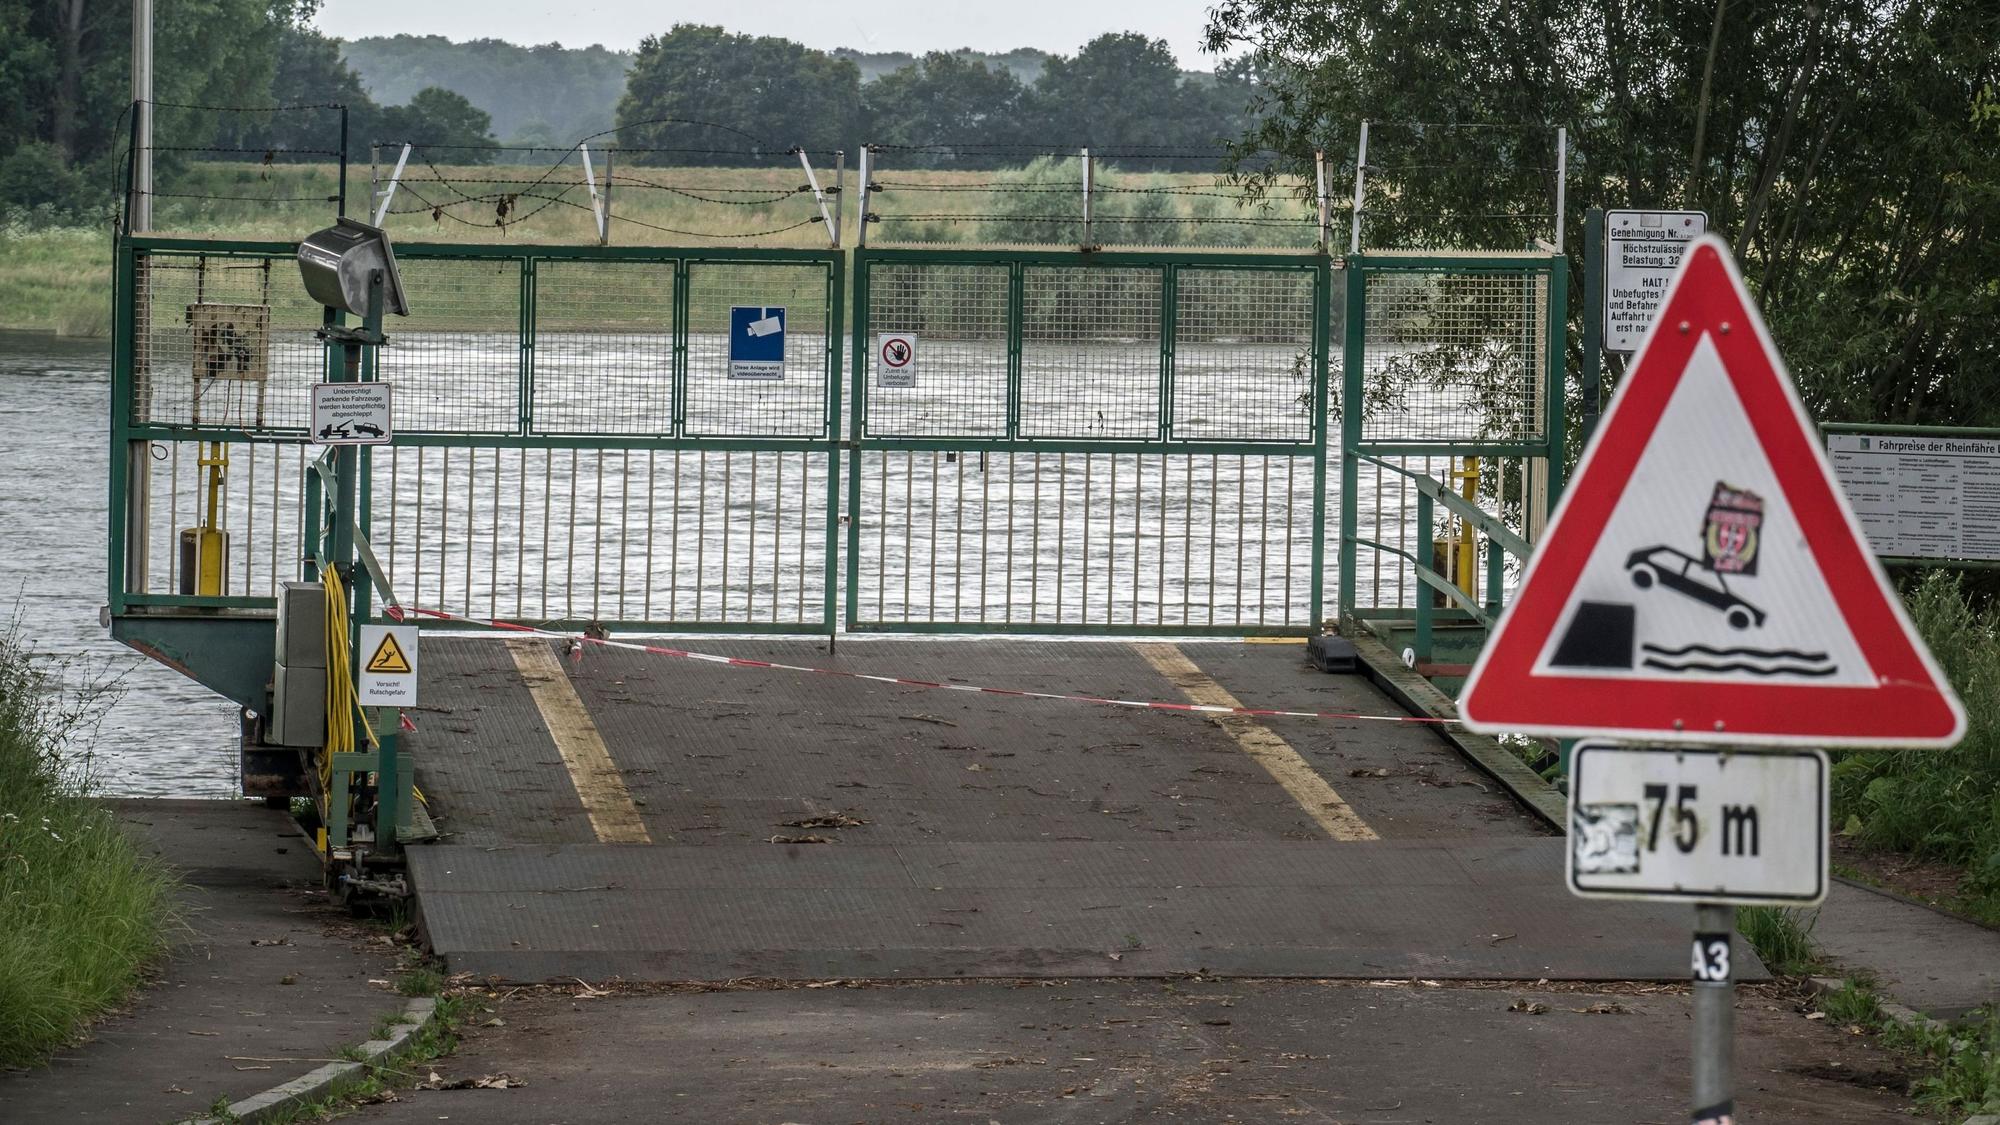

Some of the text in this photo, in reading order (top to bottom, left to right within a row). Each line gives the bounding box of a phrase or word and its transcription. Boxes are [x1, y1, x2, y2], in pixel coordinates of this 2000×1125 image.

[1611, 228, 1665, 239] Genehmigung
[1668, 229, 1679, 238] Nr.
[1623, 244, 1686, 255] Höchstzulässig
[1623, 255, 1666, 266] Belastung:
[1642, 278, 1663, 287] HALT
[1612, 289, 1659, 300] Unbefugtes
[1609, 301, 1658, 310] und Befahre
[1611, 311, 1645, 321] Auffahrt
[1616, 323, 1633, 332] erst
[1879, 440, 1926, 452] Fahrpreise
[1928, 441, 1943, 451] der
[1945, 442, 1995, 453] Rheinfähre
[1643, 784, 1760, 857] 75 m
[1691, 941, 1731, 980] A3
